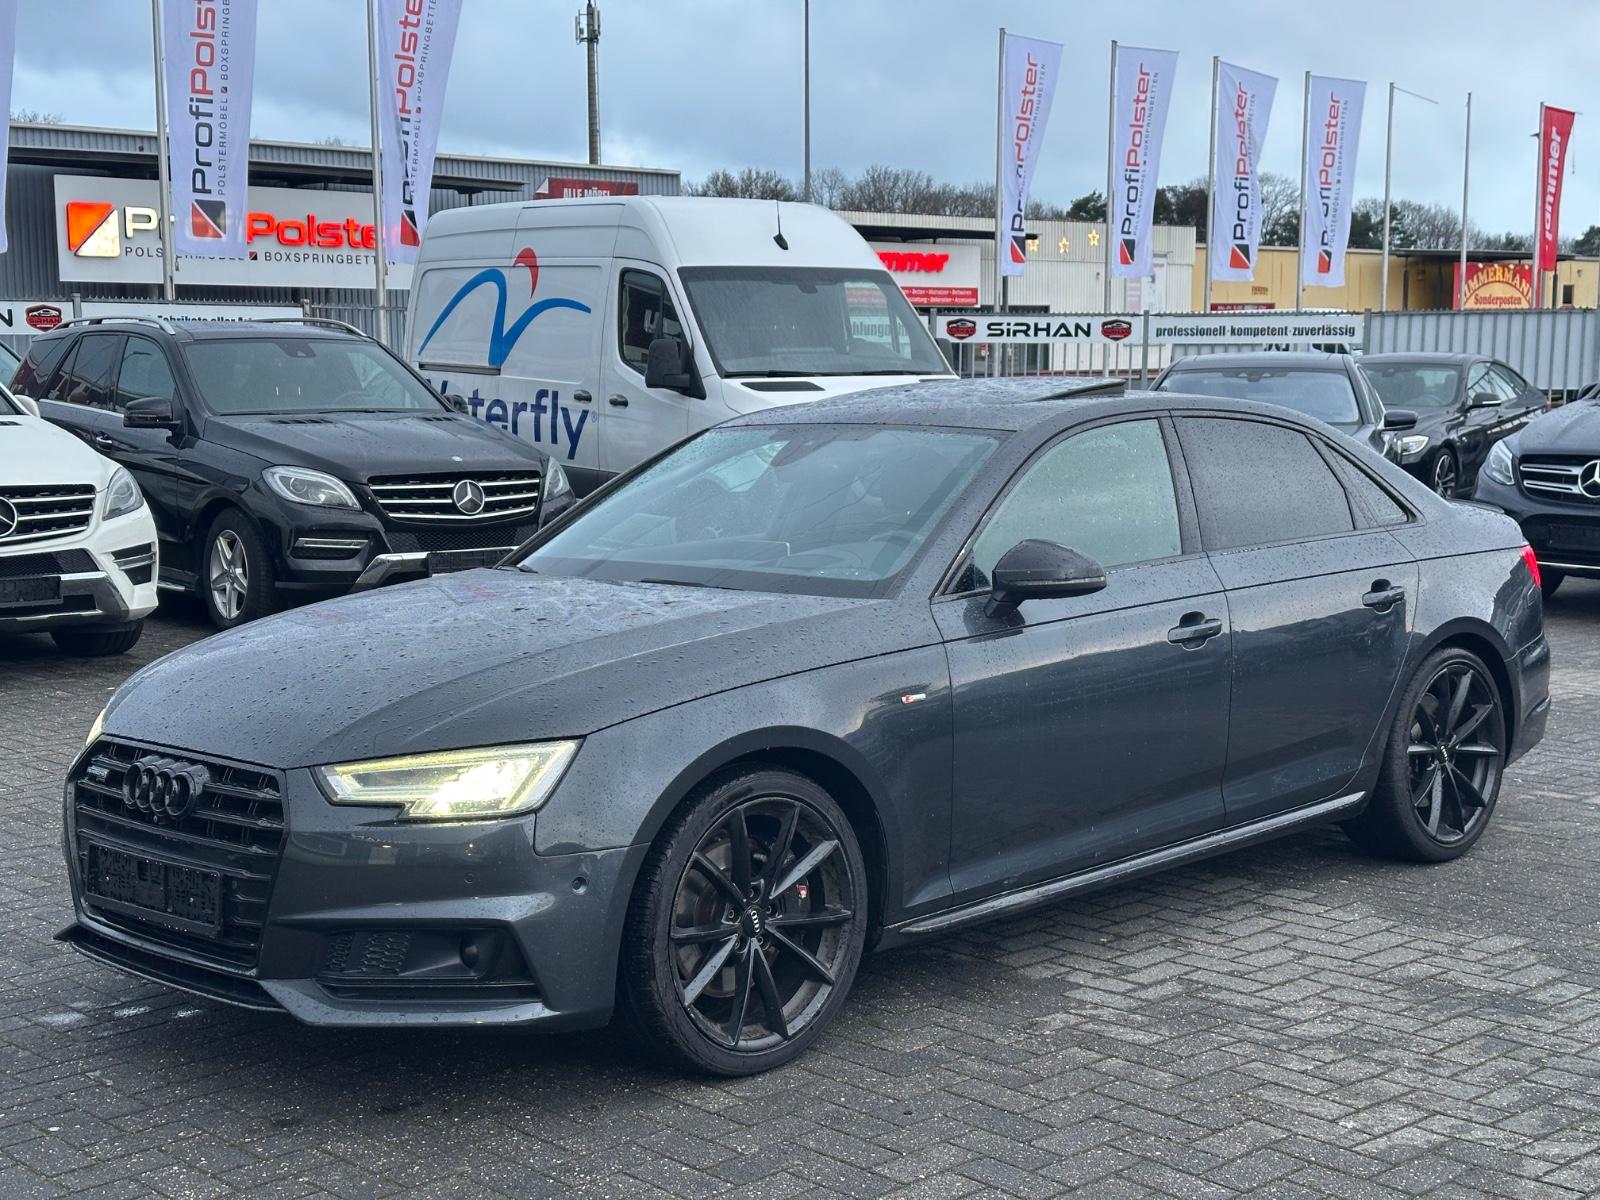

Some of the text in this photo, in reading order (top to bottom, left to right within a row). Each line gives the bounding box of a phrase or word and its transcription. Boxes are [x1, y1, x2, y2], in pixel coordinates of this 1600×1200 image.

[1120, 63, 1151, 235] ProfiPolster
[1474, 294, 1522, 307] Sonderposten
[1156, 324, 1356, 338] professionell kompetent zuverlässig
